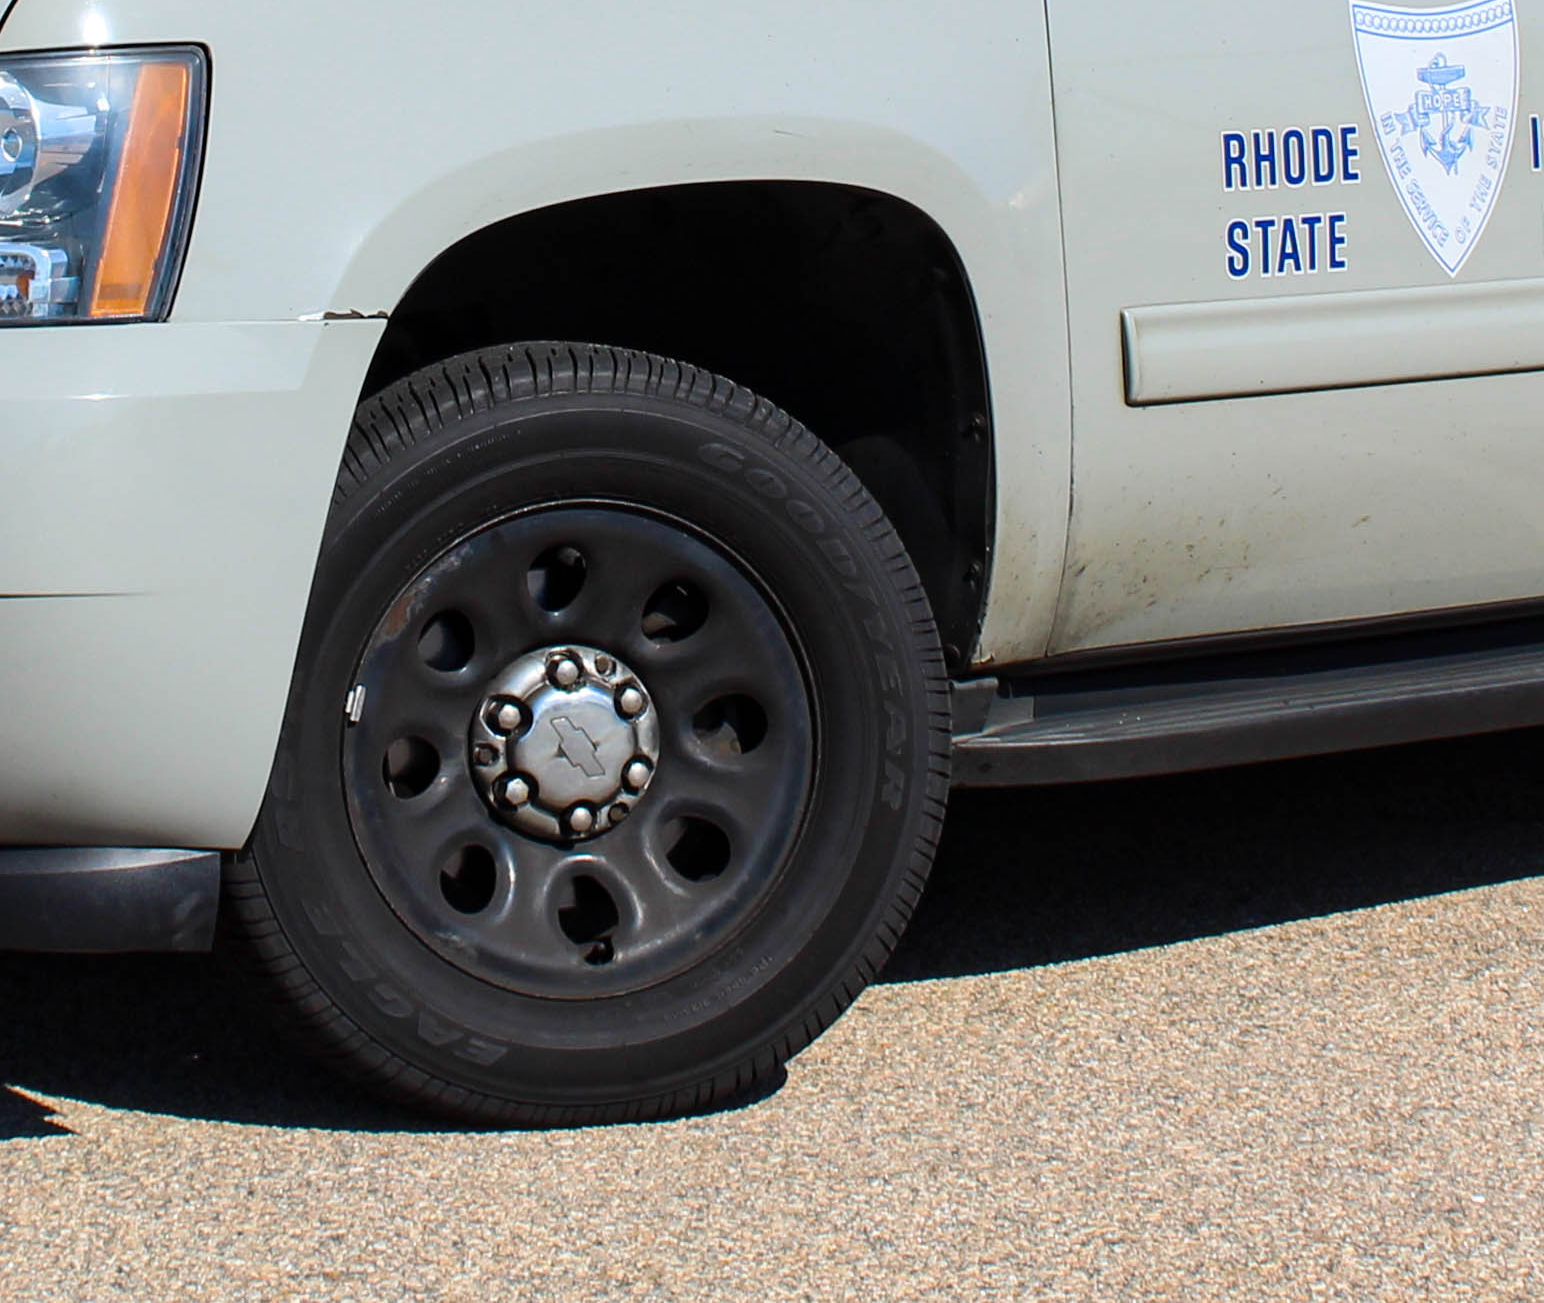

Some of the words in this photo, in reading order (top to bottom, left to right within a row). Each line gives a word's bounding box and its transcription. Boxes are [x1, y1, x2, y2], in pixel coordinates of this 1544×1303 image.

[1381, 111, 1397, 135] IN
[1422, 92, 1463, 109] HOPE
[1221, 124, 1360, 190] RHODE
[1388, 137, 1412, 181] THE
[1486, 105, 1508, 170] STATE
[1405, 178, 1451, 248] SERVICE
[1226, 213, 1348, 279] STATE
[697, 441, 907, 812] GOODYEAR
